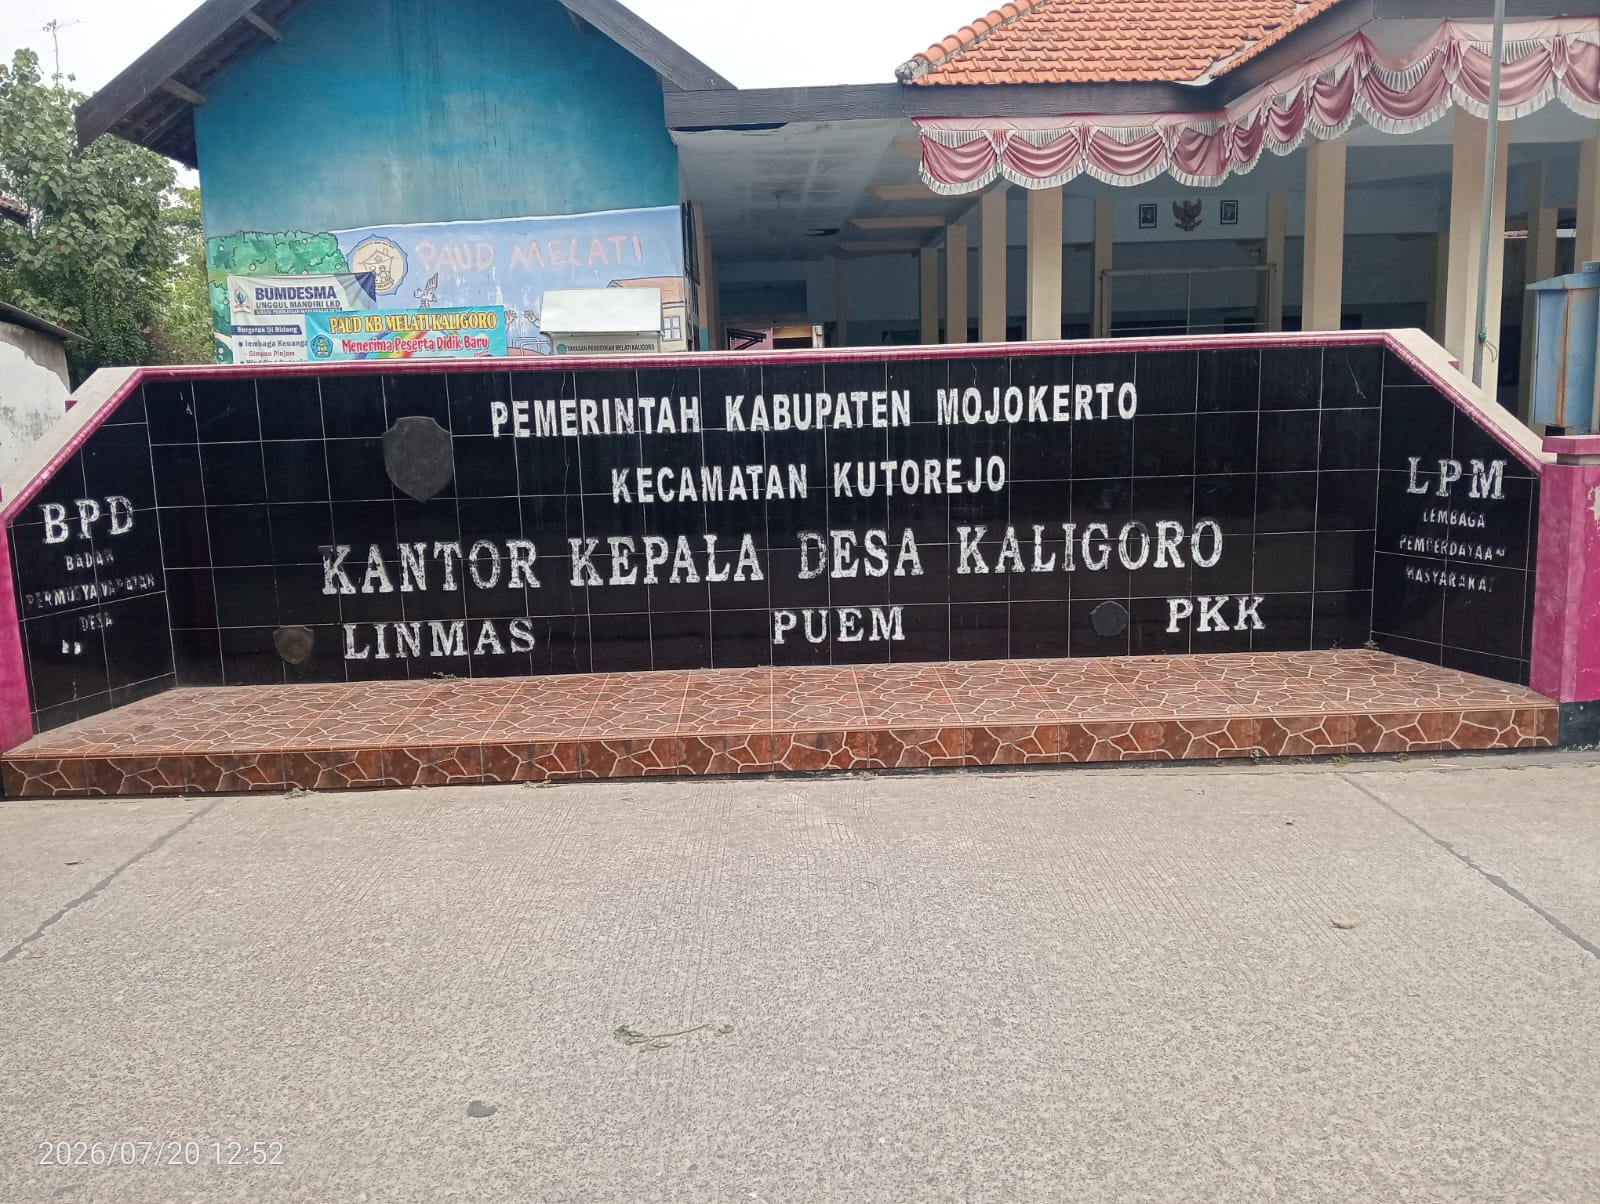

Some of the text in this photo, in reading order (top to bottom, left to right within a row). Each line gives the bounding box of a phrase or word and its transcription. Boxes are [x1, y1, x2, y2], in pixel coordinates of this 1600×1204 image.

[415, 233, 642, 272] PAUD MELATI
[255, 286, 337, 301] BUMDESMA
[256, 301, 288, 309] UNGGUL
[290, 300, 324, 308] MANDIRI
[329, 311, 498, 334] PAUD KB MELATI KALIGORO
[342, 334, 489, 354] Menerima Peserta Didik Baru
[490, 381, 1138, 438] PEMERINTAH KABUPATEN MOJOKERTO
[611, 455, 1006, 504] KECAMATAN KUTOREJO
[1406, 456, 1507, 499] LPM
[38, 495, 134, 544] BPD
[1423, 508, 1486, 529] LEMBAGA
[64, 548, 115, 571] BADAN
[319, 516, 1224, 596] KANTOR KEPALA DESA KALIGORO
[343, 595, 1267, 660] LINMAS PUEM PKK
